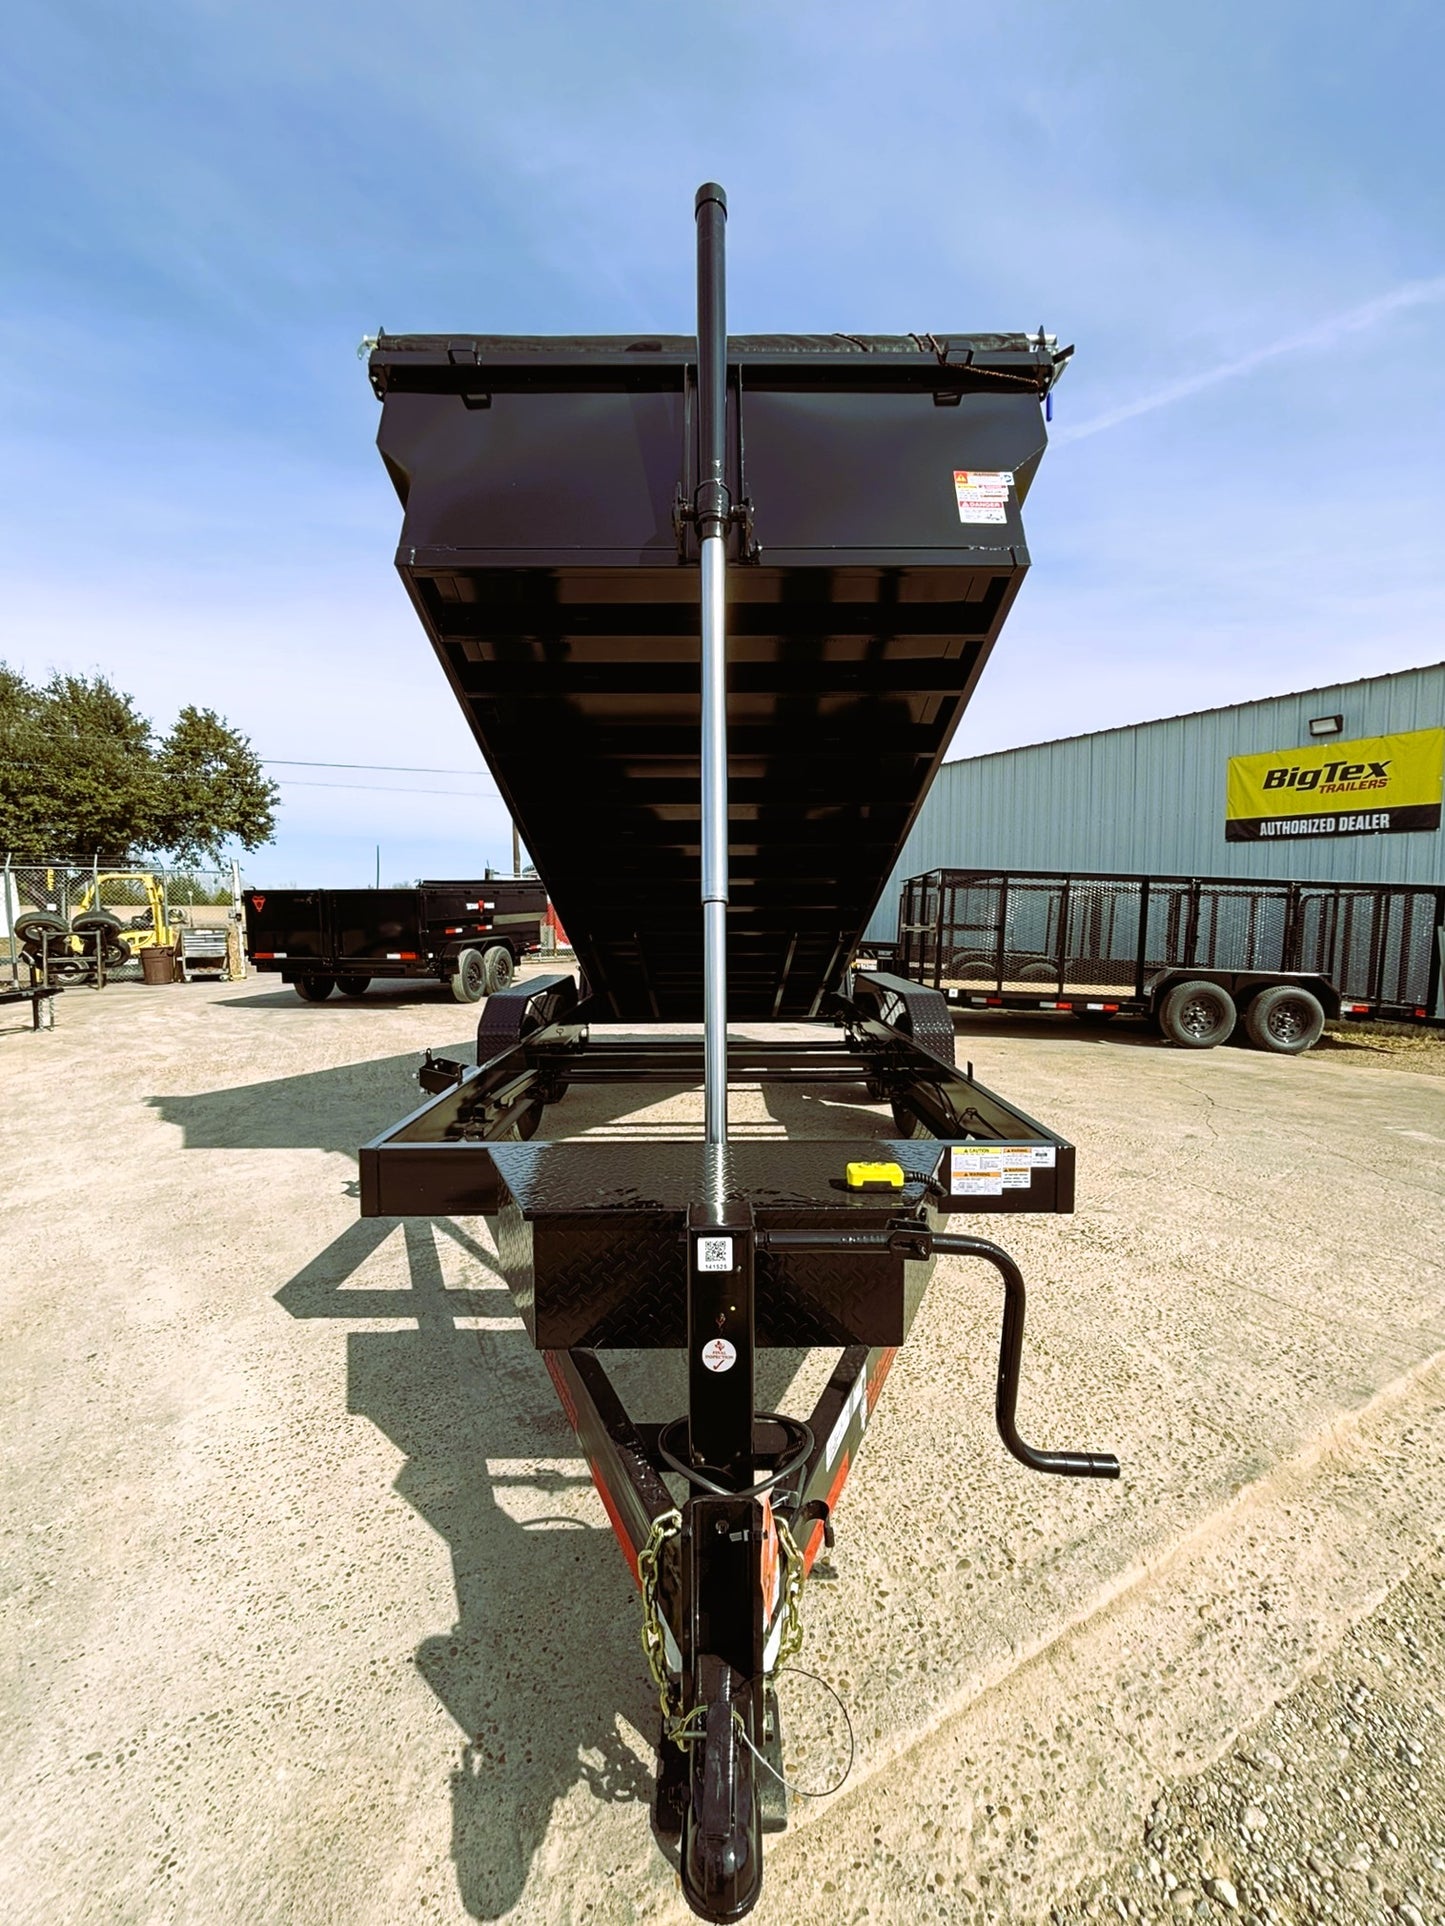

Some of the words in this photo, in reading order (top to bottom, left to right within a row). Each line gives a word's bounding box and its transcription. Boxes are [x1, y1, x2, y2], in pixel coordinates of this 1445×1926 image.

[1319, 779, 1388, 794] TRAILERS
[1260, 818, 1335, 836] AUTHORIZED
[1338, 813, 1390, 831] DEALER
